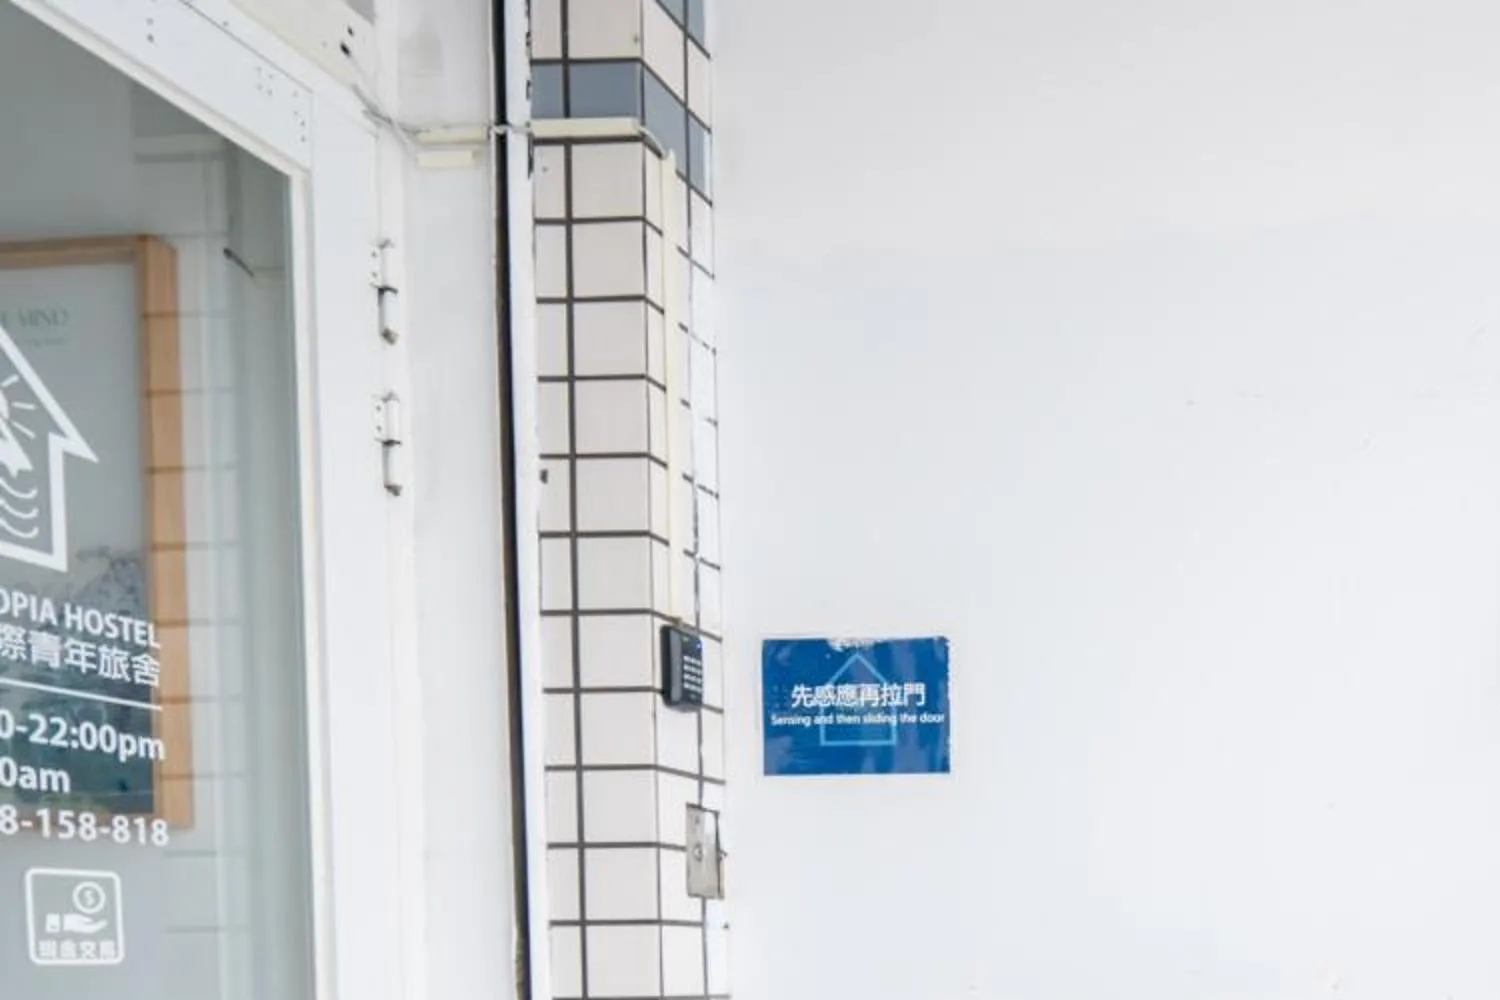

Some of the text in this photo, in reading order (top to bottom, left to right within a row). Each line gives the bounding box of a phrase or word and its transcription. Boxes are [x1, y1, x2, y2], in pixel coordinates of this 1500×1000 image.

[64, 602, 161, 649] HOSTEL
[791, 682, 926, 708] 先感應再拉門
[770, 712, 945, 727] Sensing and then sliding the door
[0, 804, 169, 847] 8-158-818
